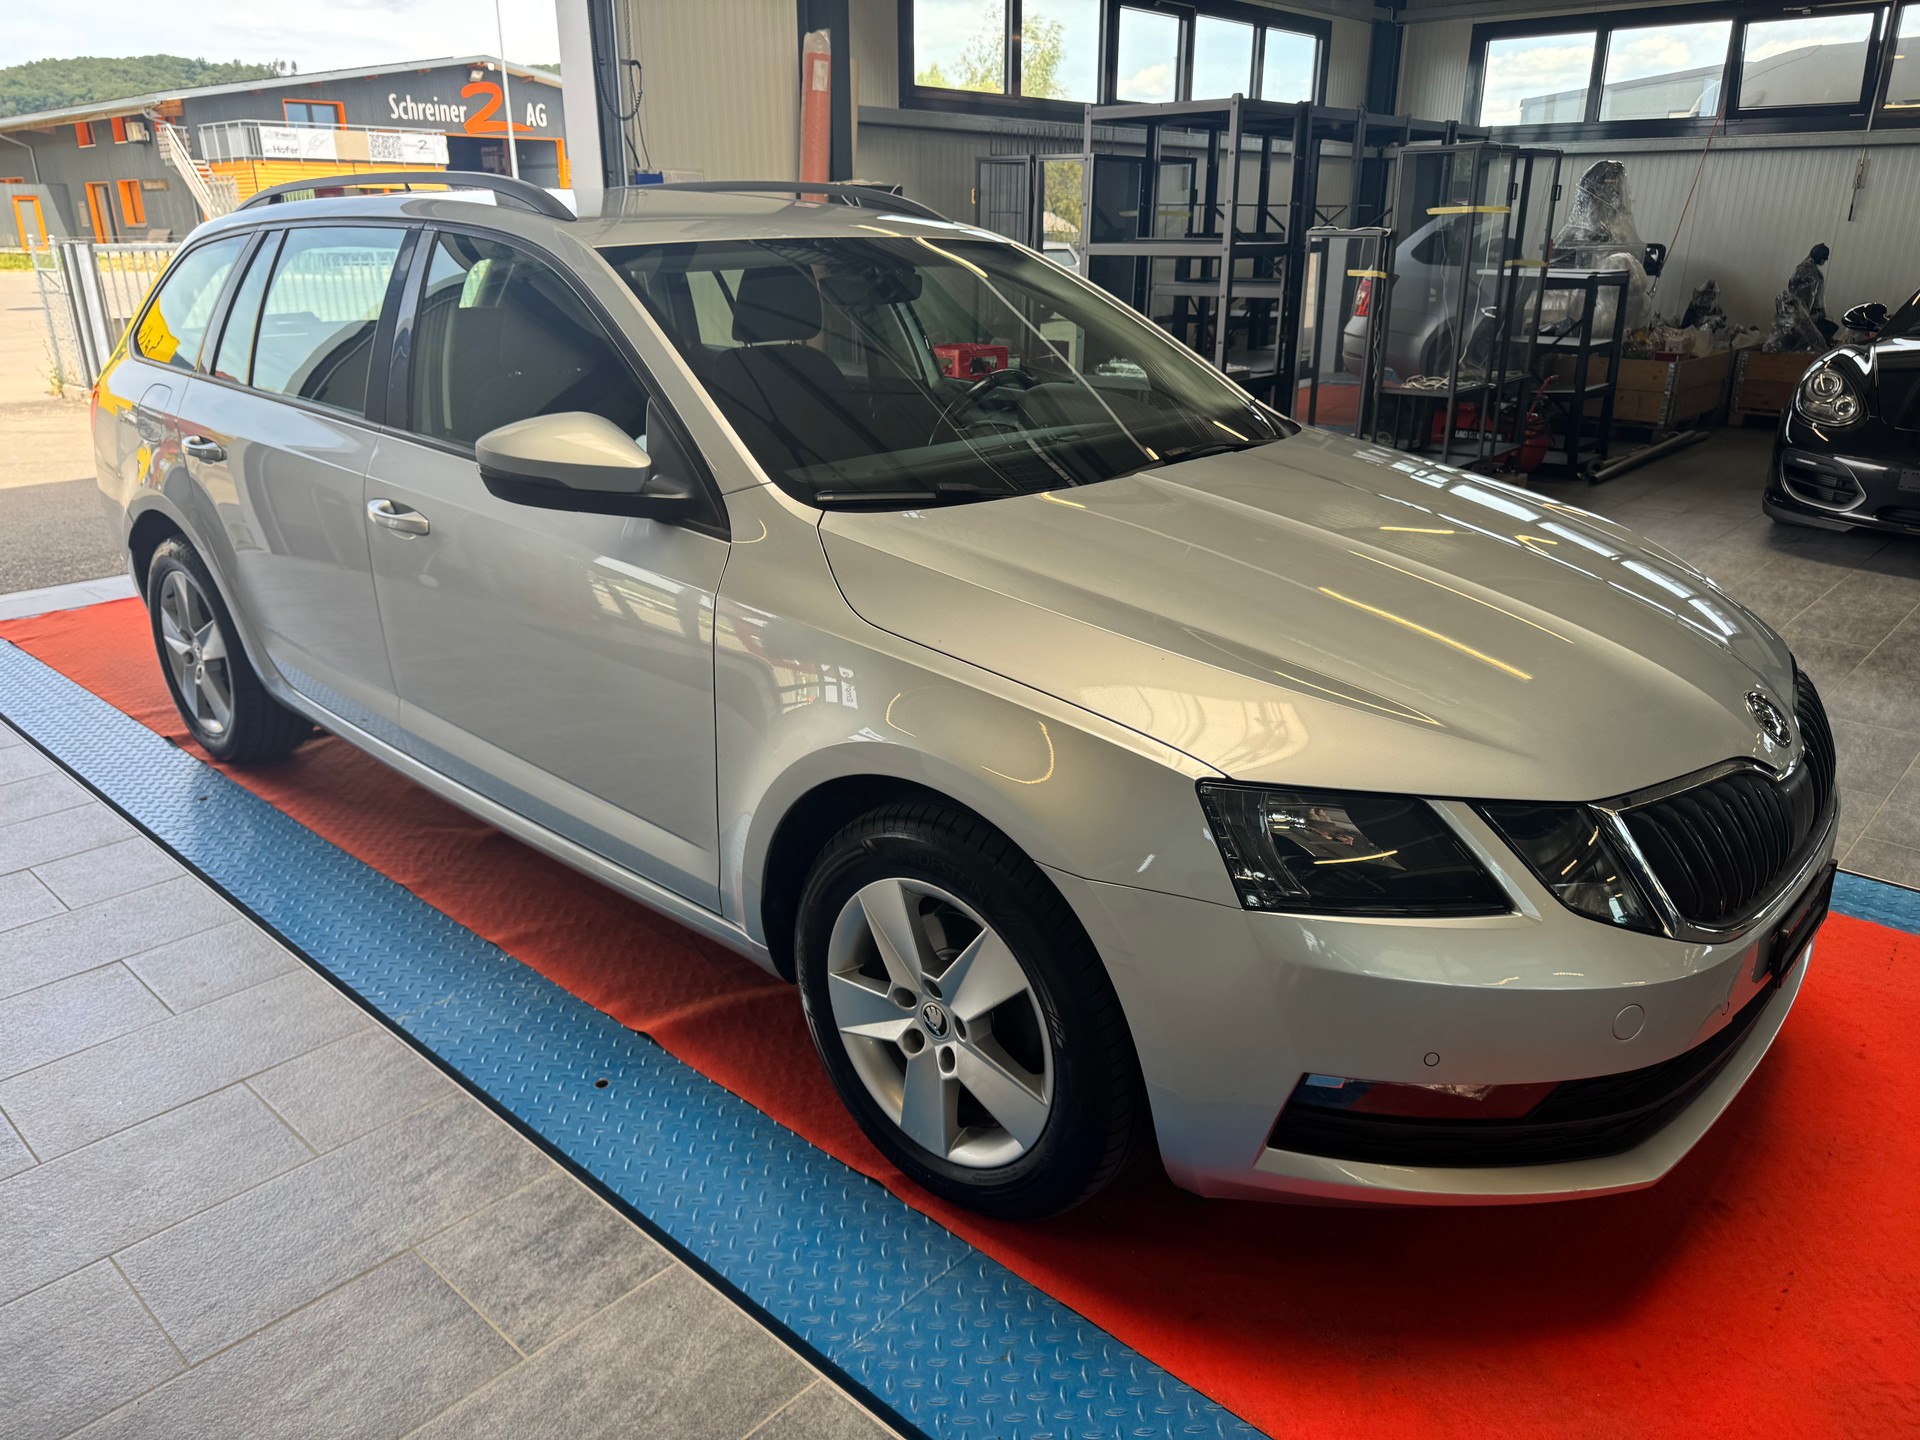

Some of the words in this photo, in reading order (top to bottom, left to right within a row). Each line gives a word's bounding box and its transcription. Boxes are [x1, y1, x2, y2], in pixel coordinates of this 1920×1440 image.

[388, 93, 467, 123] Schreiner
[461, 81, 534, 134] 2
[526, 102, 548, 127] AG
